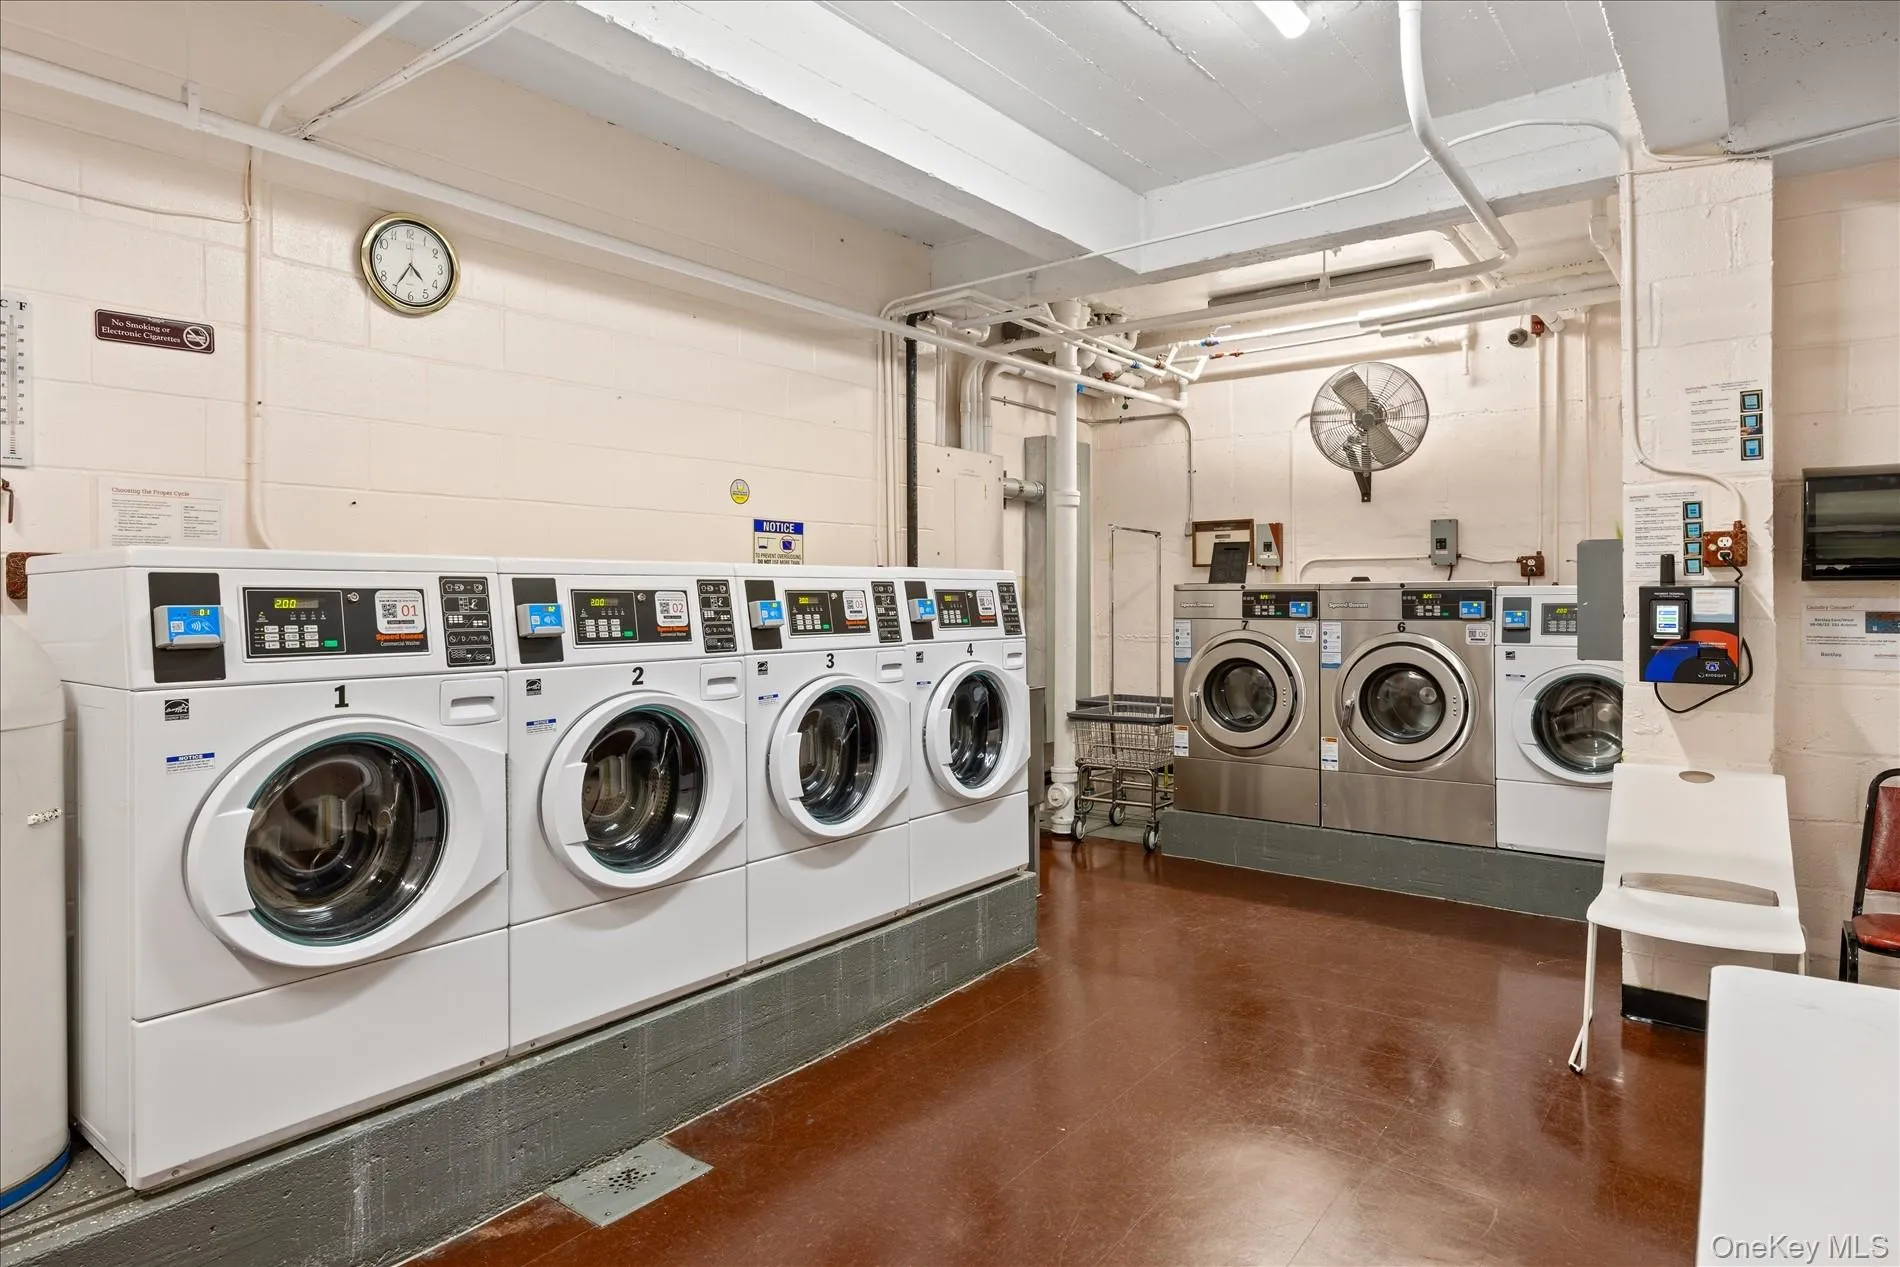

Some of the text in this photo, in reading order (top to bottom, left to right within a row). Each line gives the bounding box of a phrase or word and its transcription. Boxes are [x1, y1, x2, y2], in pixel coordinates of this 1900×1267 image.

[391, 230, 397, 240] 11
[406, 228, 414, 240] 12
[380, 238, 388, 250] 10
[423, 236, 427, 246] 1
[376, 254, 382, 264] 9
[432, 248, 439, 259] 2
[437, 264, 443, 275] 3
[380, 270, 387, 281] 8
[432, 280, 438, 290] 4
[407, 291, 414, 301] 6
[422, 289, 429, 299] 5
[112, 318, 124, 326] No
[126, 320, 160, 332] Smoking
[101, 326, 180, 343] Electronic Cigarettes
[112, 487, 140, 495] Choosing
[763, 522, 795, 533] NOTICE
[274, 599, 296, 608] 2.00
[672, 603, 684, 613] 02
[855, 600, 864, 608] 03
[402, 604, 418, 617] 01
[1242, 620, 1248, 630] 7
[1397, 622, 1405, 633] 6
[967, 643, 973, 656] 4
[826, 653, 834, 668] 3
[632, 666, 644, 686] 2
[334, 684, 349, 708] 1
